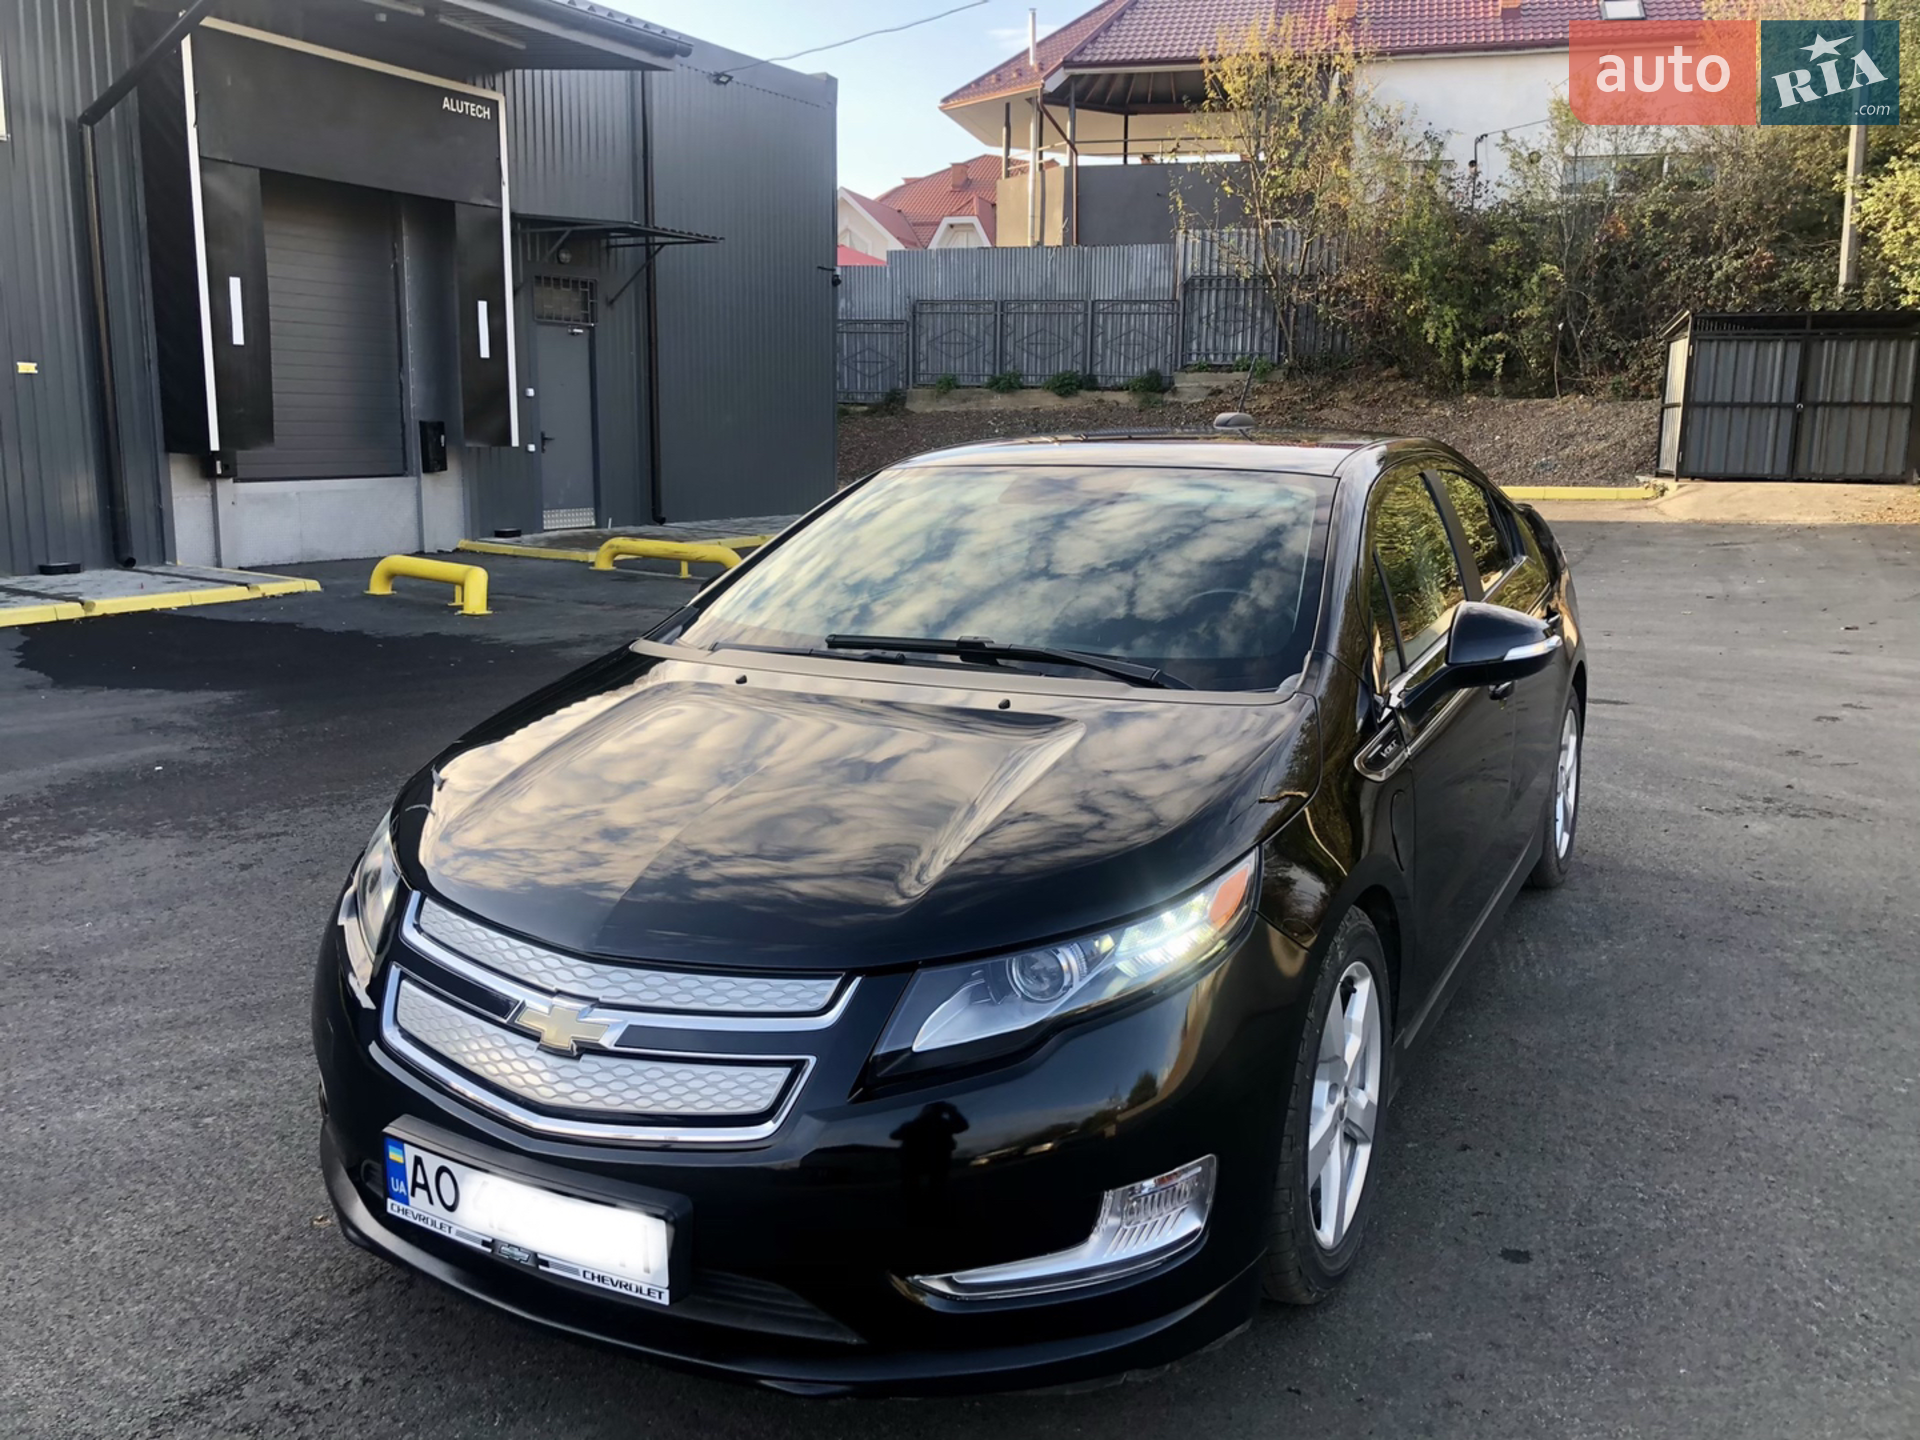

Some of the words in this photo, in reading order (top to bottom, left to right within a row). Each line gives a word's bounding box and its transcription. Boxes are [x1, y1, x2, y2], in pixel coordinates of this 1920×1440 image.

[442, 96, 491, 120] ALUTECH
[391, 1176, 407, 1196] UA
[390, 1202, 453, 1235] CHEVROLET
[582, 1269, 665, 1301] CHEVROLET
